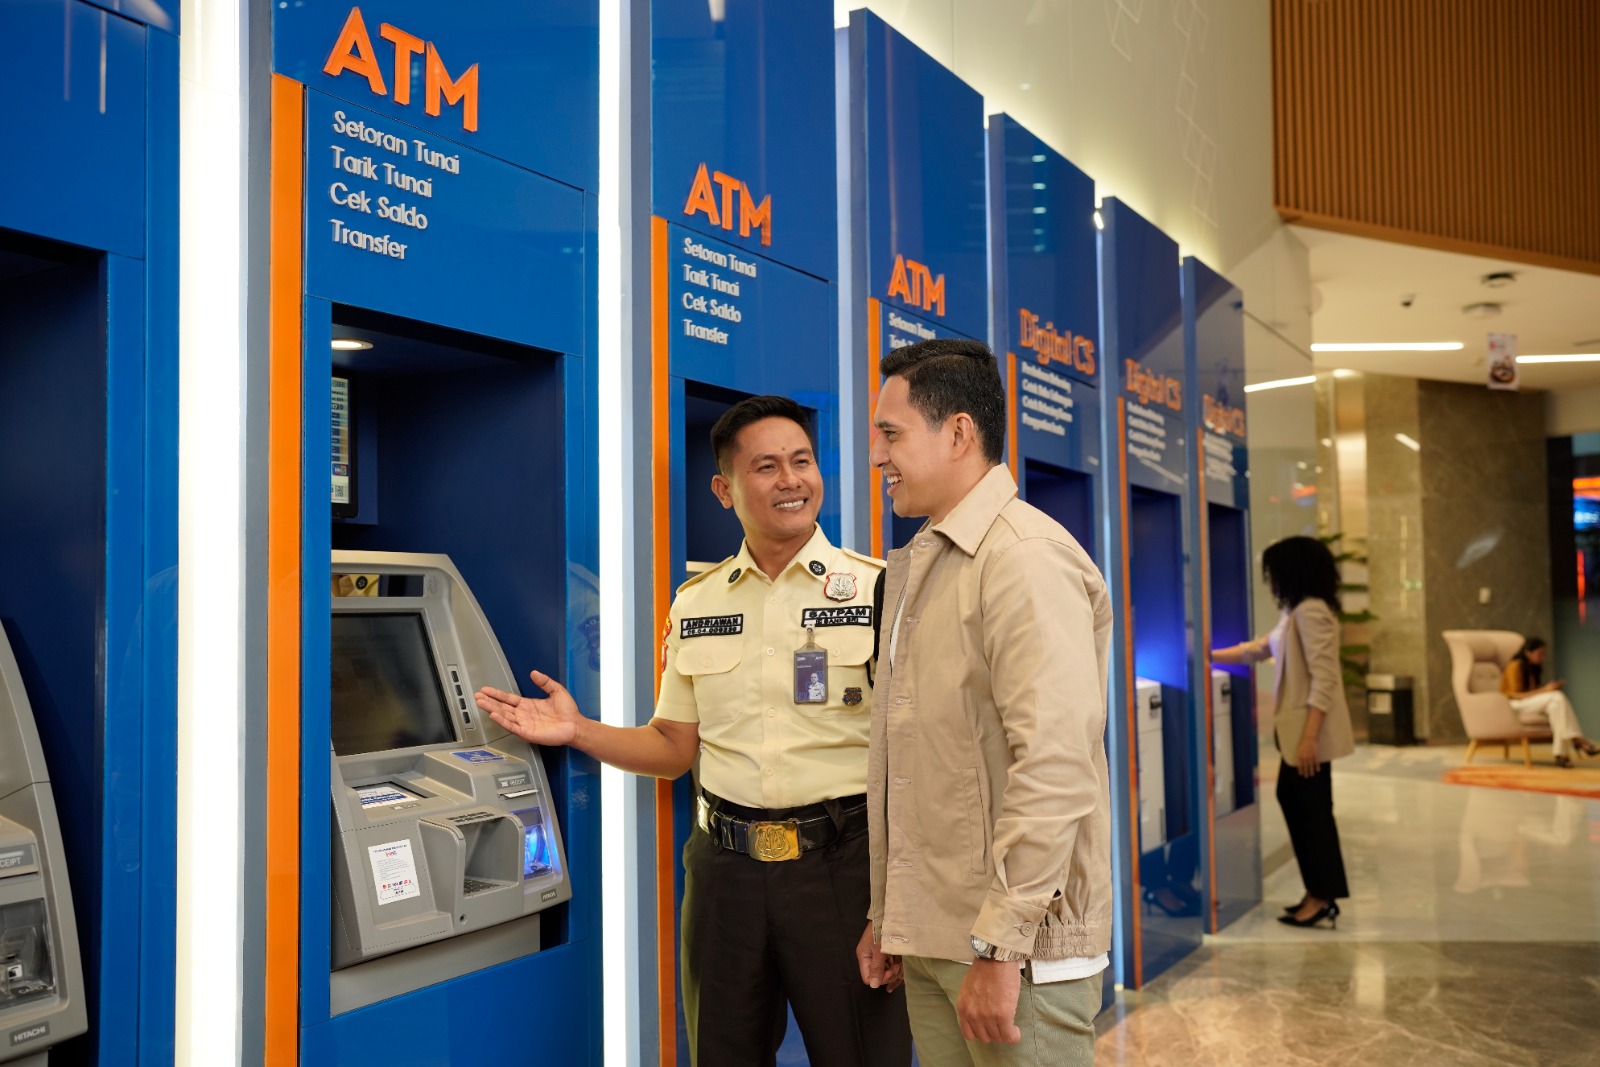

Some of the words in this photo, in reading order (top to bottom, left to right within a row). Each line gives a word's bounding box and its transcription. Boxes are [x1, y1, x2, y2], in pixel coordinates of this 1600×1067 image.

[322, 6, 479, 133] ATM
[333, 110, 408, 156] Setoran
[413, 139, 460, 175] Tunai
[330, 145, 378, 181] Tarik
[383, 162, 433, 198] Tunai
[329, 182, 372, 214] Cek
[377, 196, 428, 230] Saldo
[683, 162, 772, 247] ATM
[329, 218, 408, 260] Transfer
[683, 237, 727, 268] Setoran
[728, 253, 757, 278] Tunai
[682, 263, 710, 288] Tarik
[710, 272, 740, 297] Tunai
[887, 253, 946, 317] ATM
[682, 292, 707, 314] Cek
[710, 298, 742, 323] Saldo
[682, 318, 729, 345] Transfer
[1019, 308, 1073, 366] Digital
[1073, 335, 1096, 376] CS
[685, 616, 739, 630] ANDRIAWAN
[809, 608, 867, 618] SATPAM
[14, 1026, 46, 1043] HITACHI
